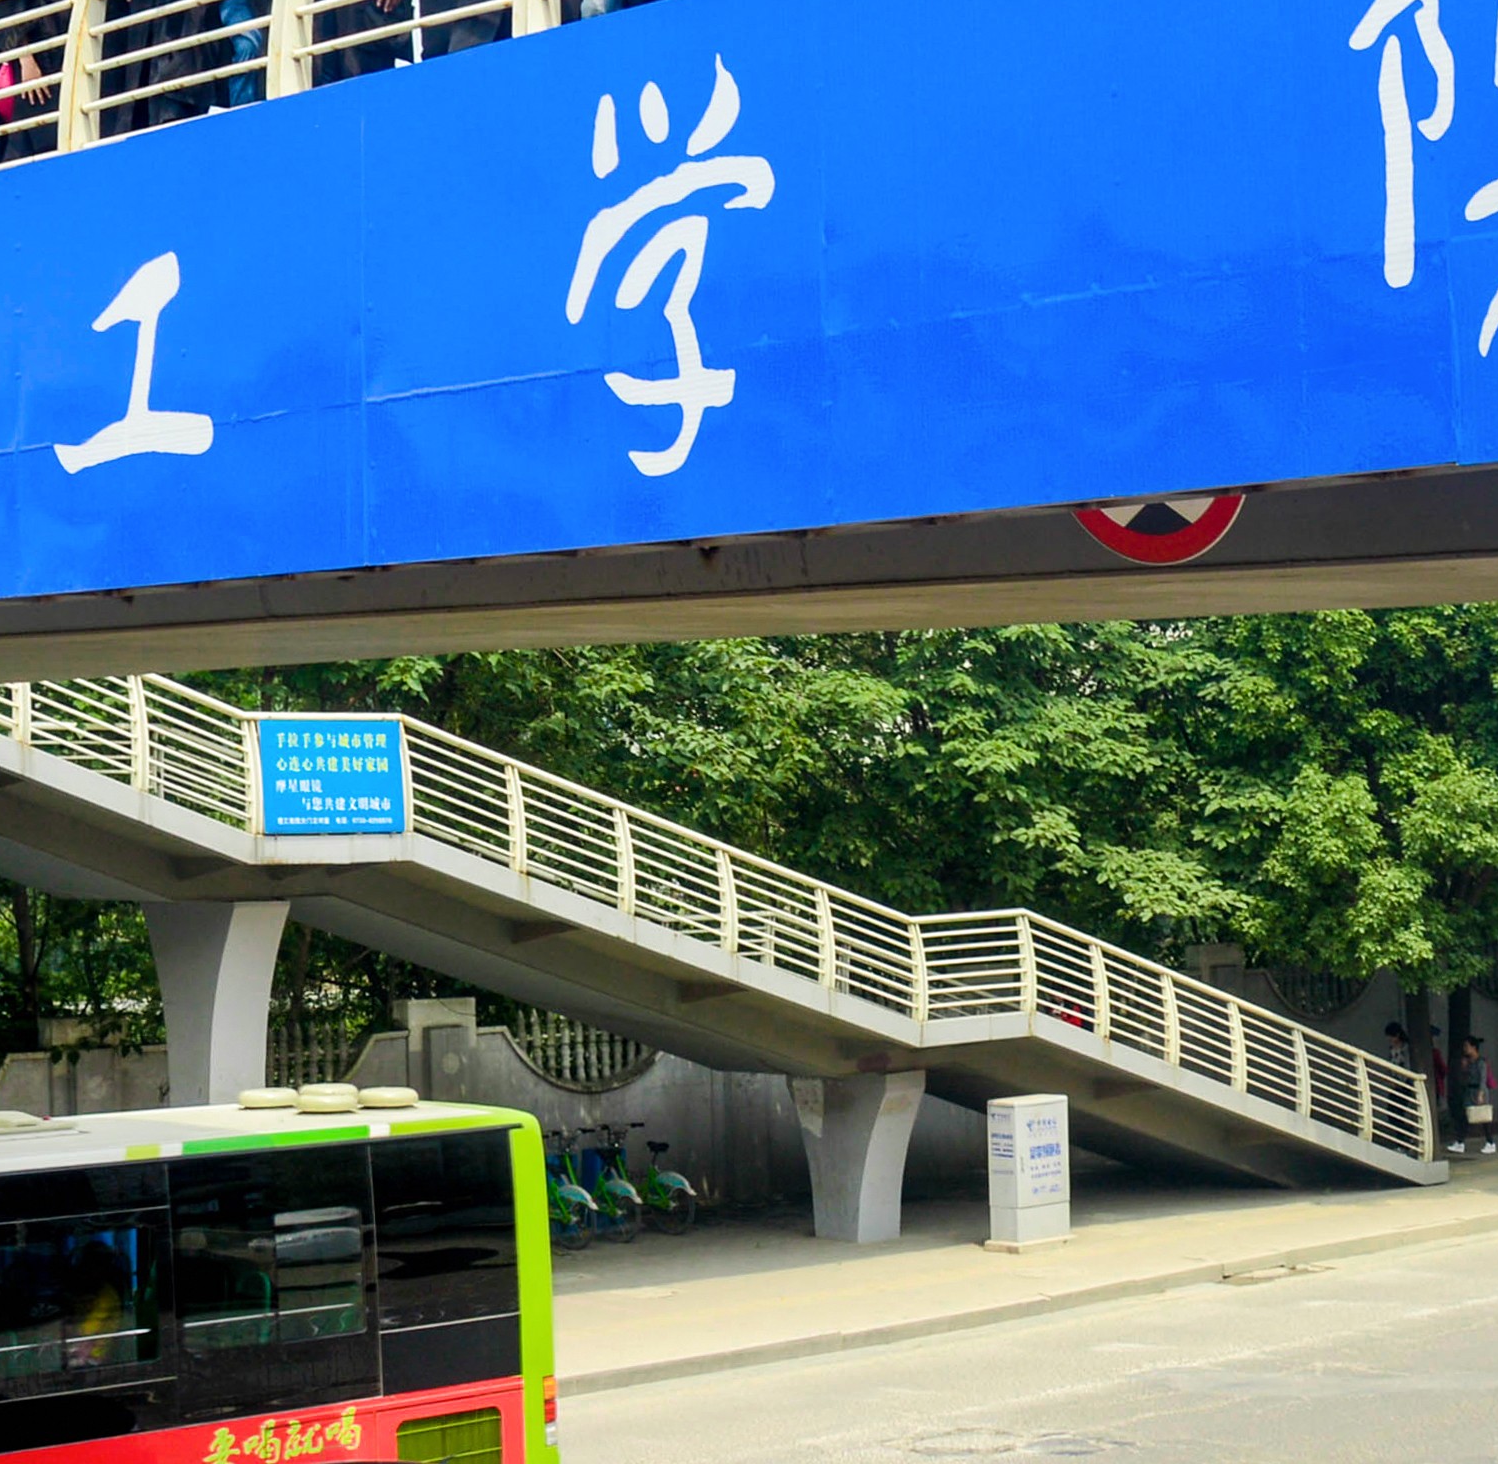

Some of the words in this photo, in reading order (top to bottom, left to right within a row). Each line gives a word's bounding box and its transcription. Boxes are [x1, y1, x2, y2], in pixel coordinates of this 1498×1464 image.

[276, 732, 388, 749] 手拉手参与城市管理
[276, 755, 390, 773] 心连心共建美好家园
[301, 796, 392, 811] 与您共建文明城市
[203, 1406, 362, 1464] 要喝就喝
